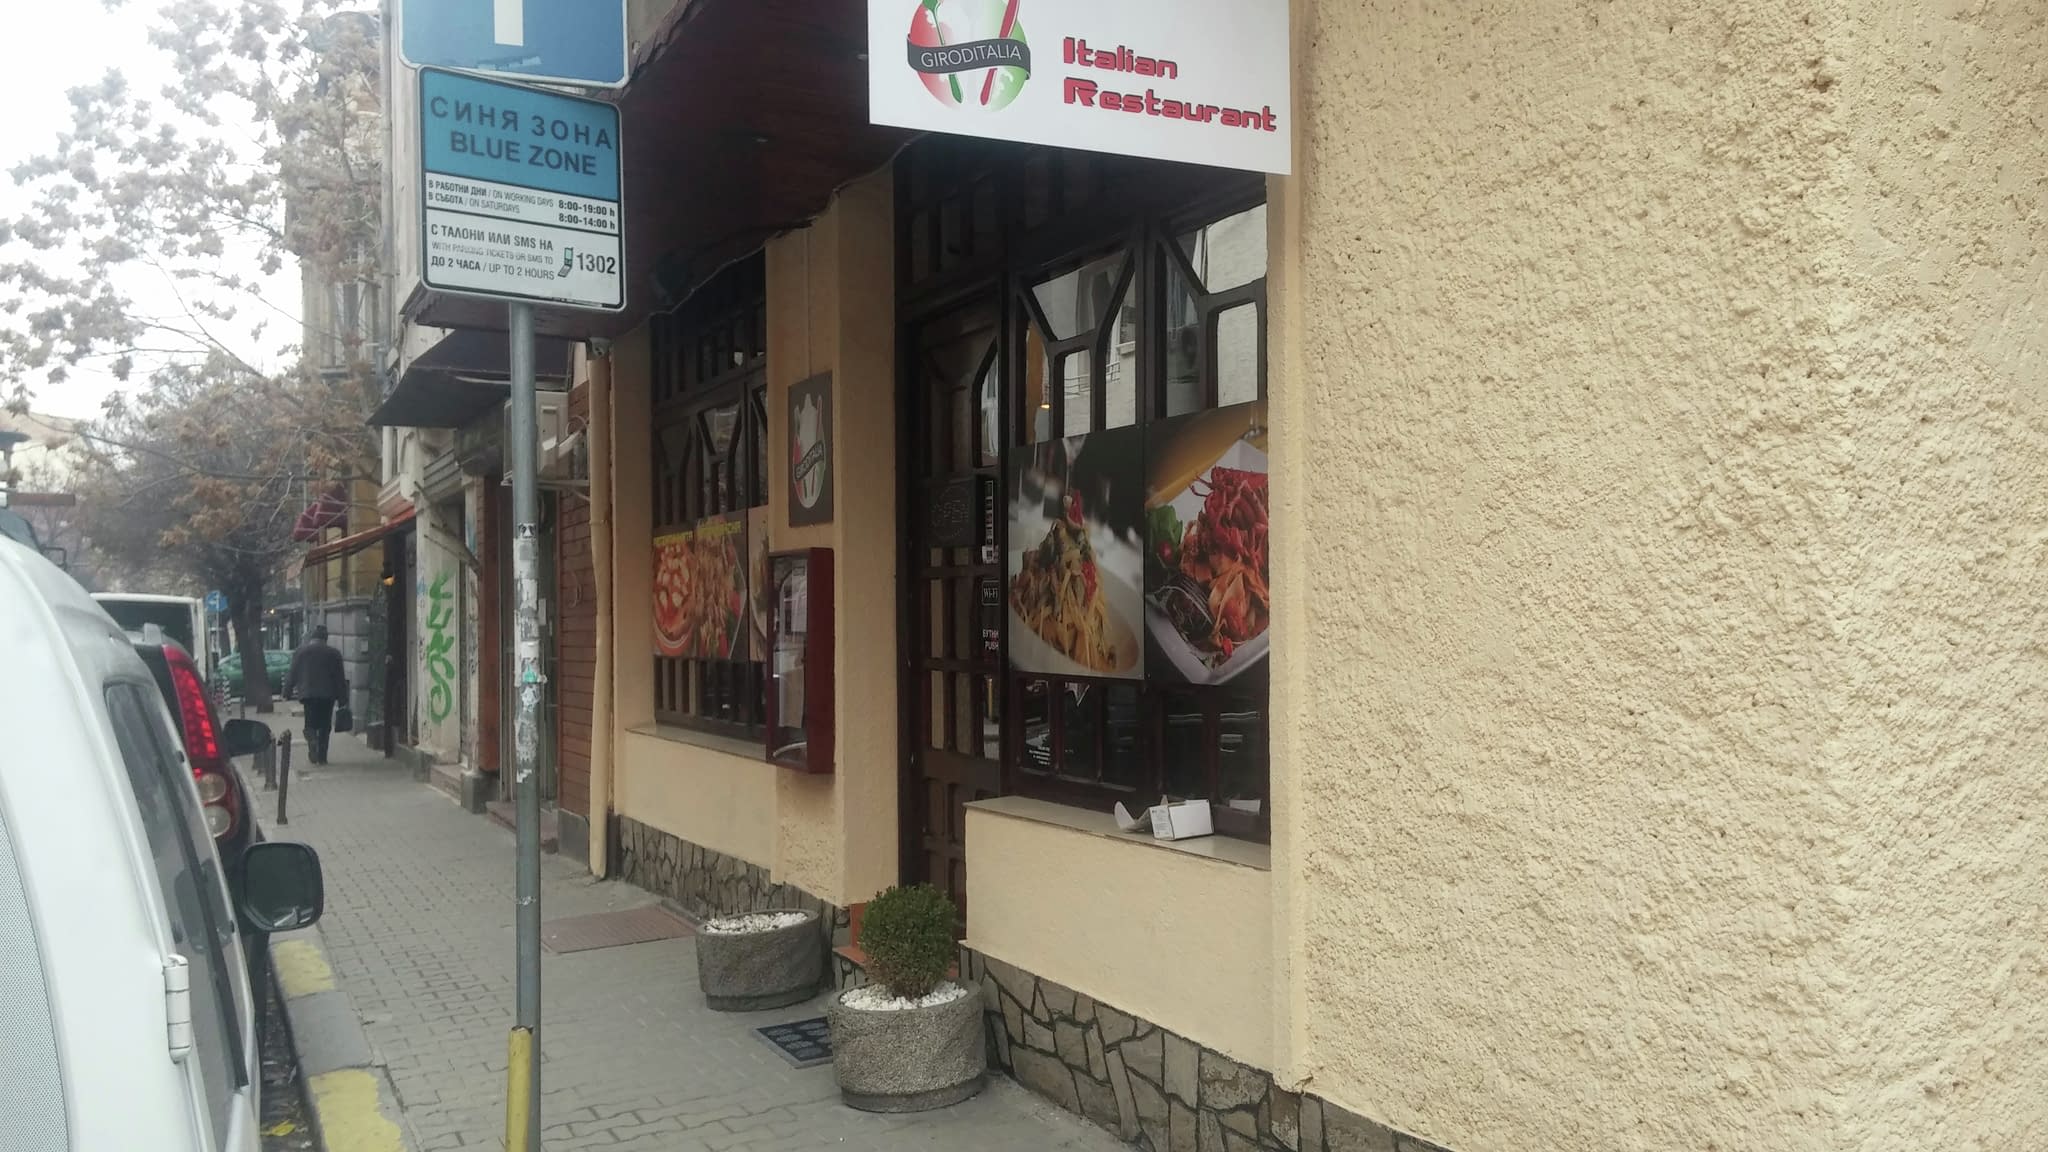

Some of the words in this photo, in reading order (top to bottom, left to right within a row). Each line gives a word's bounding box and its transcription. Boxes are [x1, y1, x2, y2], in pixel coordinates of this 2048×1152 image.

[920, 44, 1022, 68] GIRODITALIA
[1062, 36, 1179, 80] Italian
[430, 95, 519, 133] СИНЯ
[531, 115, 613, 150] ЗОНА
[1062, 76, 1278, 133] Restaurant
[450, 131, 521, 162] BLUE
[528, 145, 598, 176] ZONE
[435, 181, 469, 194] РАБОТНИ
[470, 186, 487, 197] ДНИ
[492, 189, 503, 199] ON
[505, 191, 536, 205] WORKING
[537, 196, 554, 208] DAYS
[558, 199, 607, 216] 8:00-19:00
[609, 208, 615, 217] h
[435, 192, 463, 204] СЪБОТА
[469, 197, 480, 207] ON
[481, 199, 520, 214] SATURDAYS
[558, 213, 608, 229] 8:00-14:00
[609, 221, 616, 230] h
[432, 241, 451, 252] WITH
[486, 248, 514, 260] TICKETS
[544, 255, 554, 265] TO
[441, 225, 485, 242] ТАЛОНИ
[488, 232, 511, 246] ИЛИ
[514, 235, 537, 249] SMS
[539, 238, 554, 251] НА
[431, 255, 445, 267] ДО
[448, 257, 454, 268] 2
[456, 258, 481, 271] ЧАСА
[488, 262, 501, 273] UP
[503, 264, 515, 276] TO
[517, 266, 523, 276] 2
[524, 267, 555, 280] HOURS
[576, 252, 616, 275] 1302
